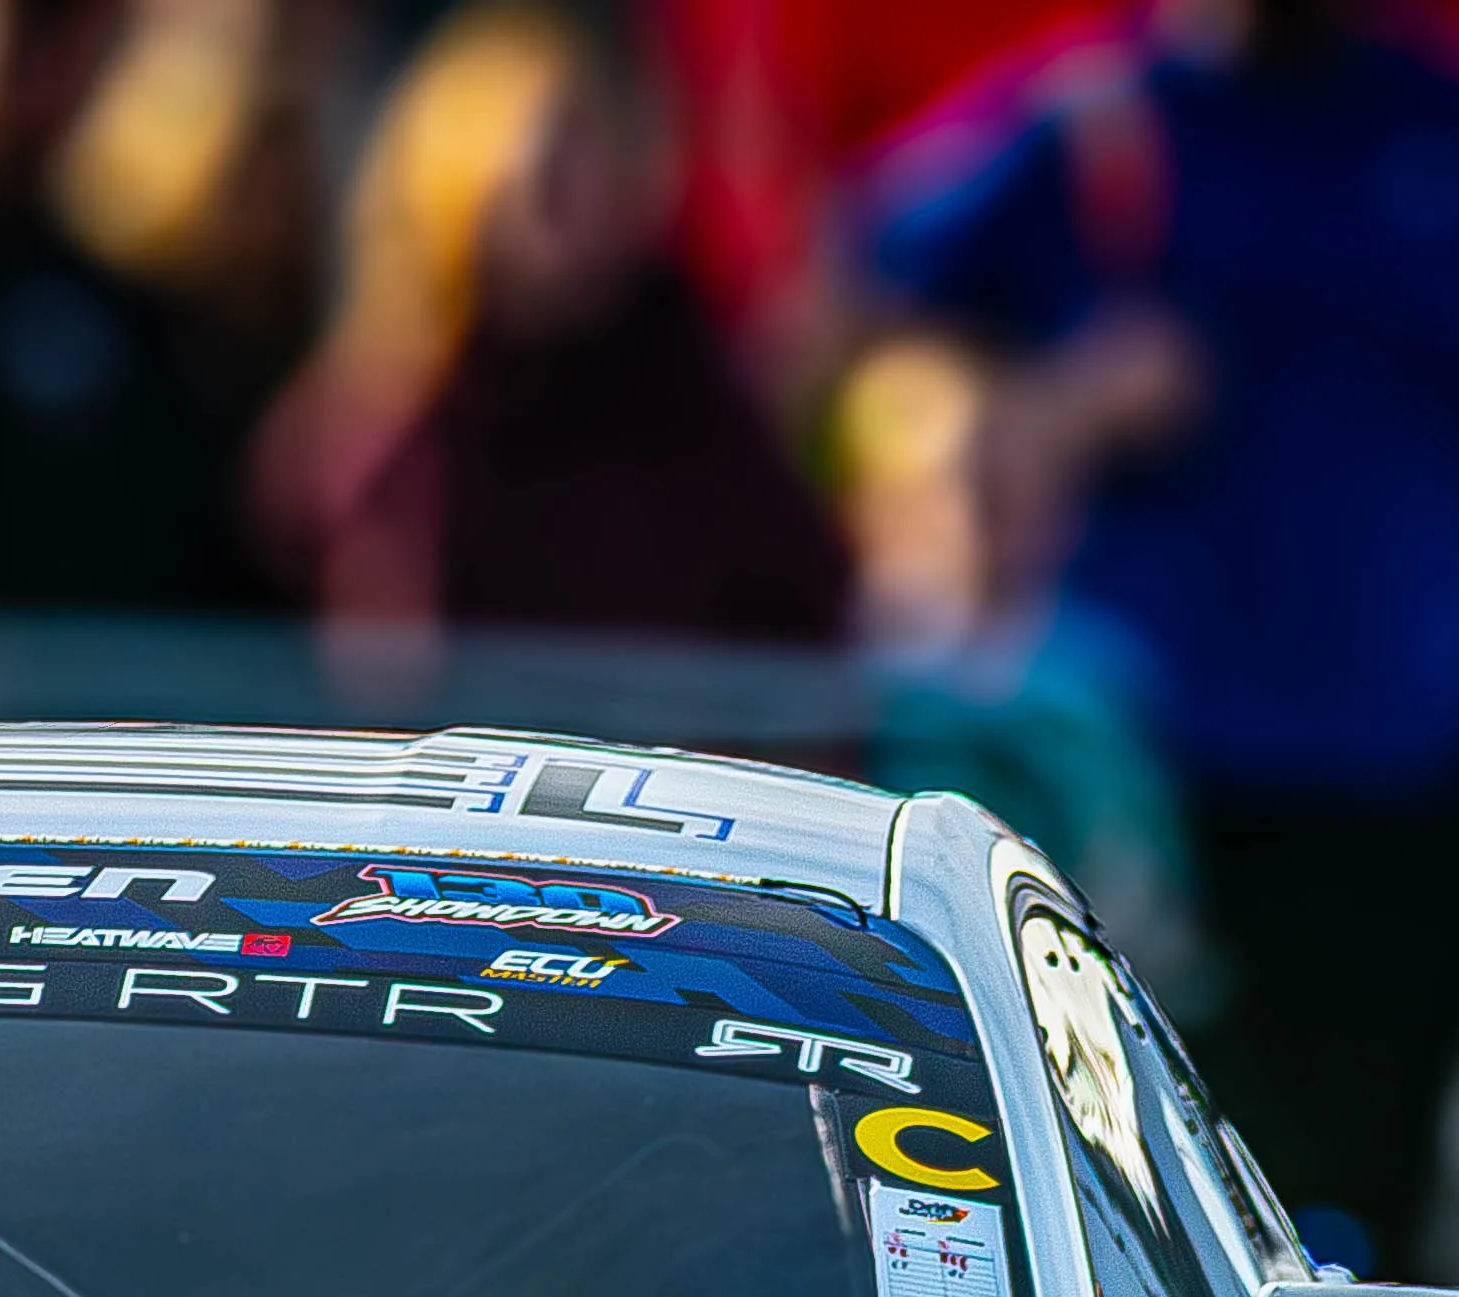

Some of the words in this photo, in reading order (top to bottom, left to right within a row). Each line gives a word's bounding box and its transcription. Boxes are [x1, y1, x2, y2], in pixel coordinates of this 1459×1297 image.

[373, 868, 645, 916] 130
[336, 896, 663, 932] SHOWDOWN
[10, 925, 243, 953] HEATWAVE
[490, 950, 629, 979] ECU
[117, 967, 504, 1034] RTR
[855, 1107, 1002, 1190] C
